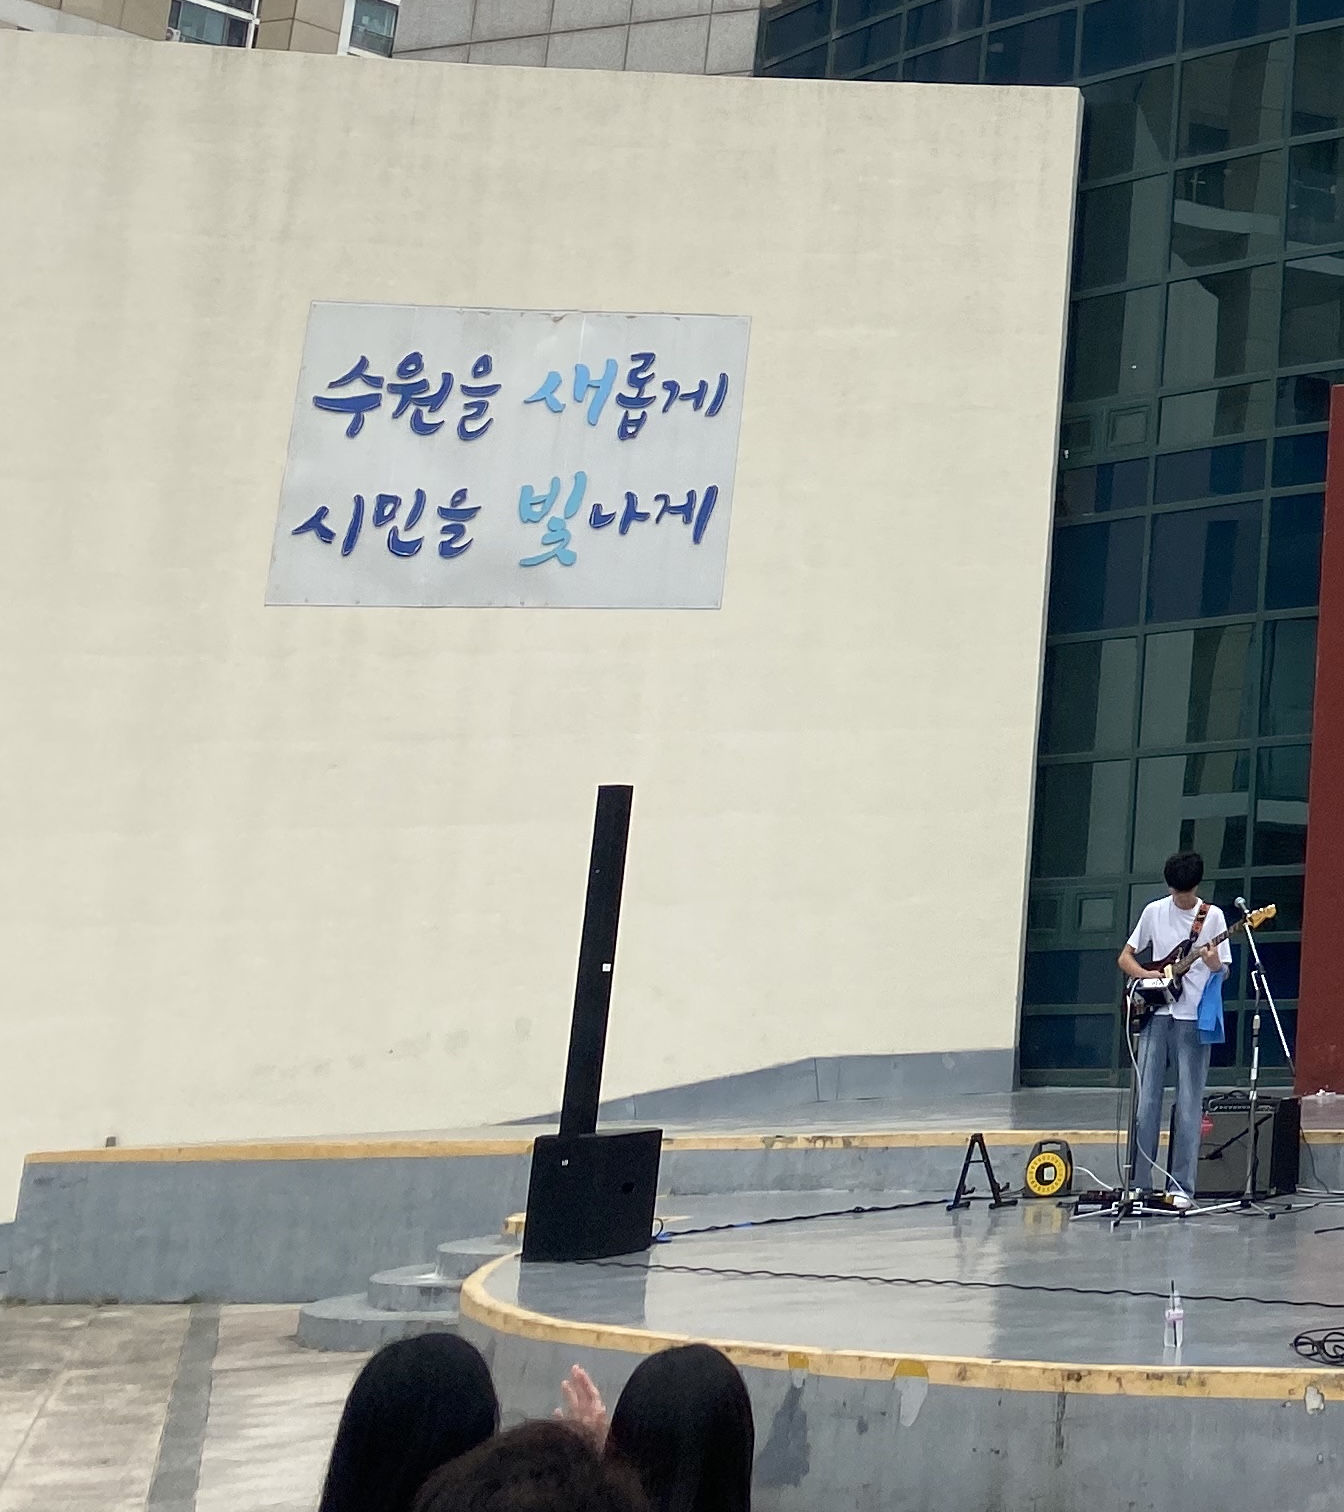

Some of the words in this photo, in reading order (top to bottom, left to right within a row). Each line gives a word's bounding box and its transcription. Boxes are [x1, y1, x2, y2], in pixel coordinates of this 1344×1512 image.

[312, 351, 502, 440] 수원을
[523, 352, 730, 440] 새롭게
[291, 487, 482, 559] 시민을
[518, 471, 720, 567] 빛나게
